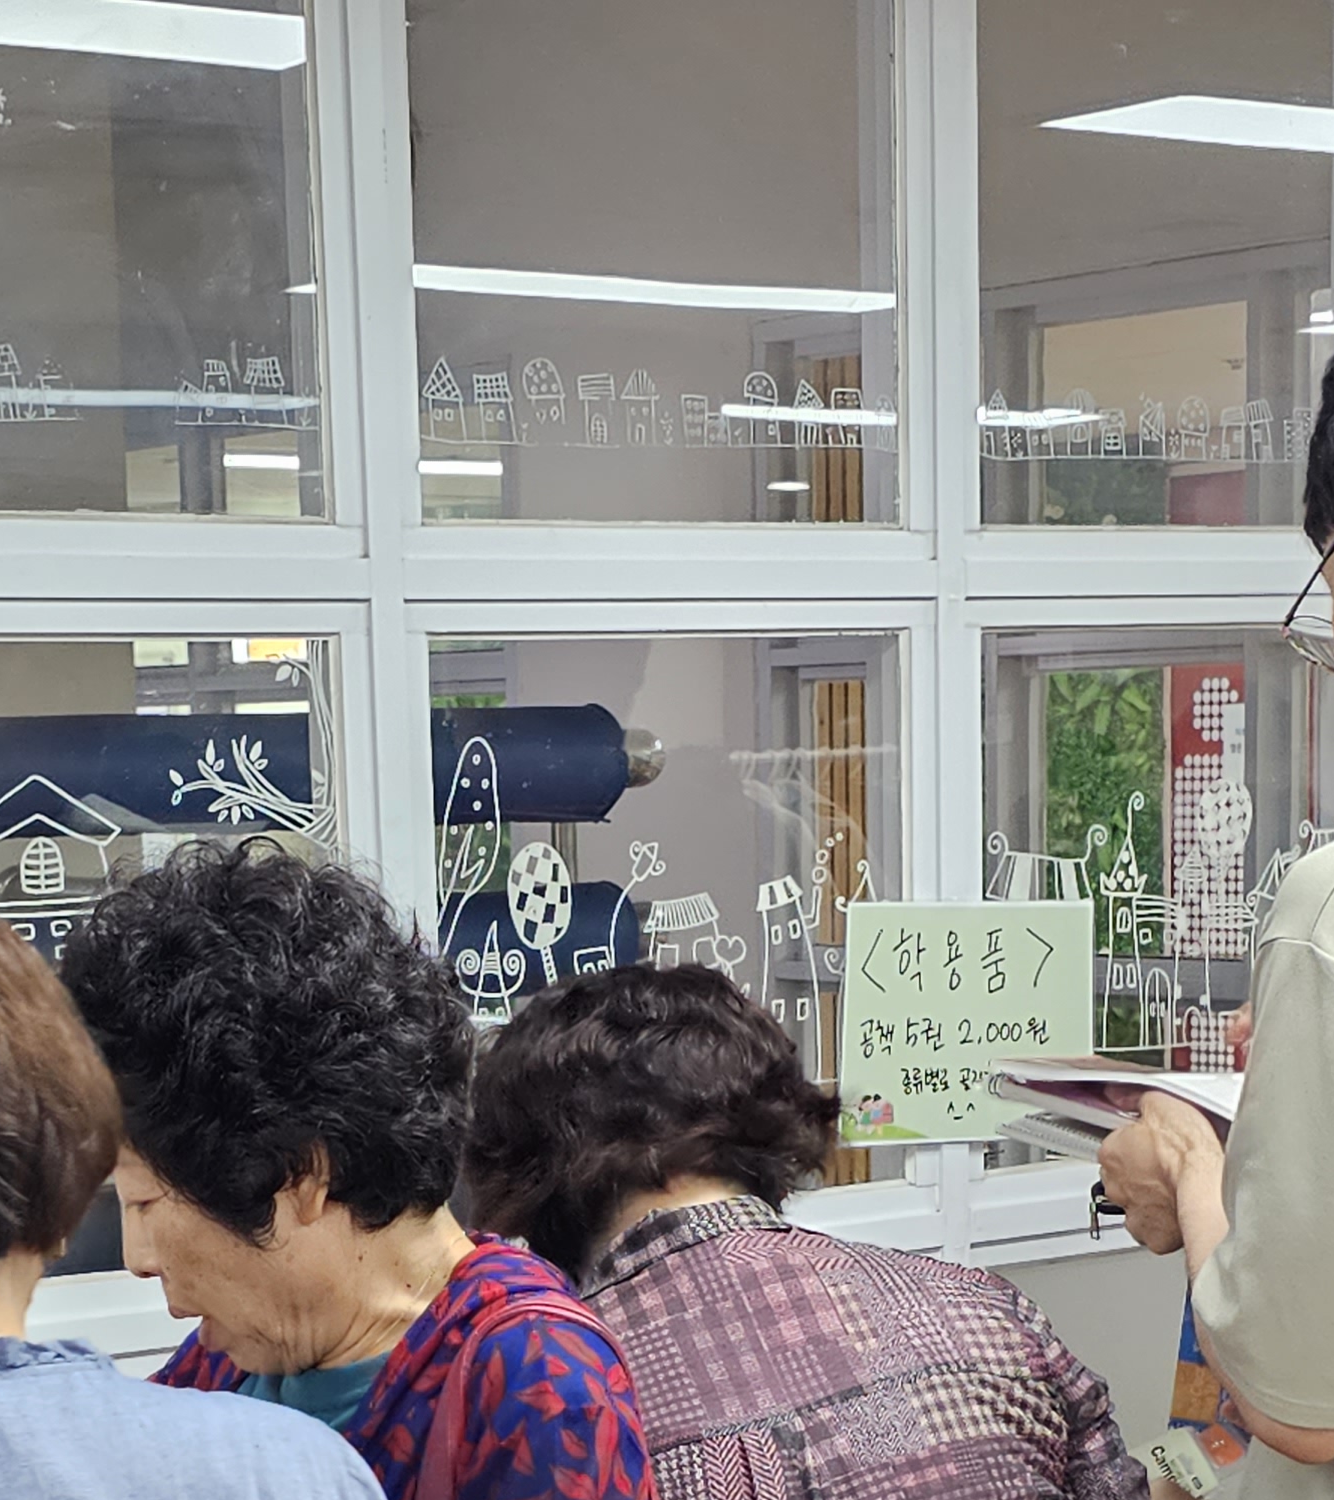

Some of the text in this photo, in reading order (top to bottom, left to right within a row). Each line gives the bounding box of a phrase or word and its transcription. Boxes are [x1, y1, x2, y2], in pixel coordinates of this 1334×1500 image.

[859, 1016, 1051, 1059] 공책 5권 2,000원
[900, 1067, 950, 1095] 종류별로
